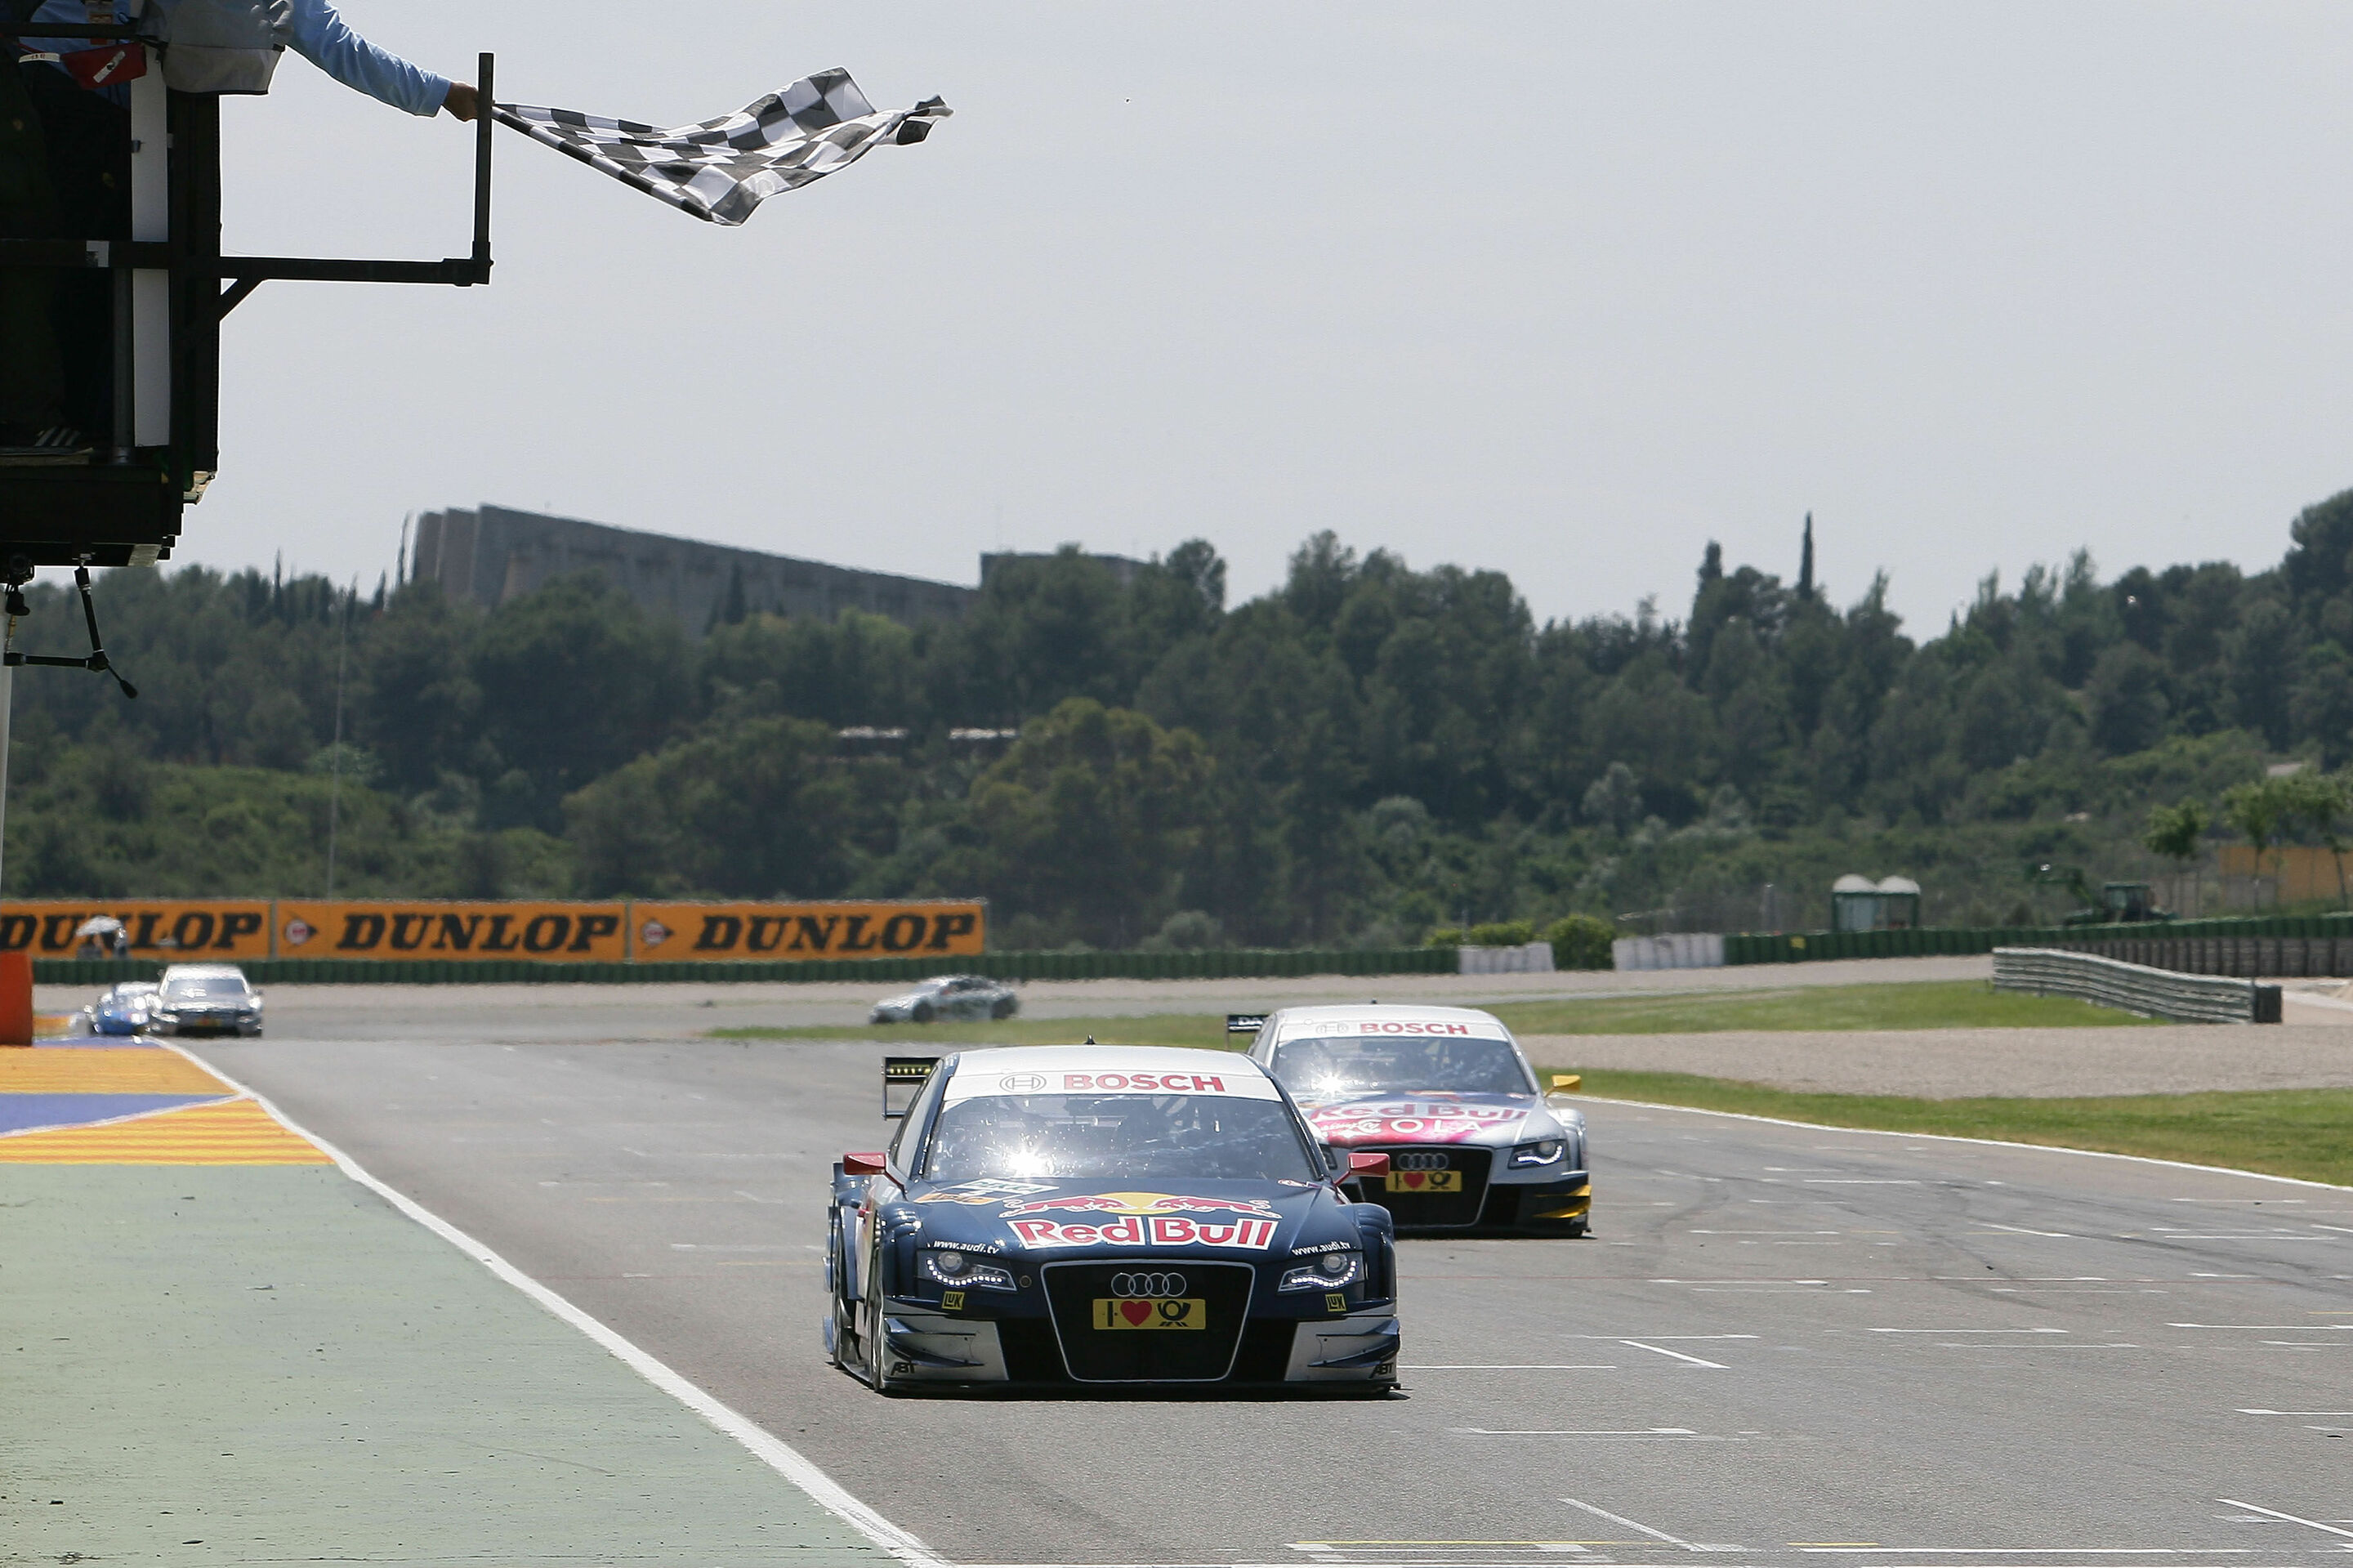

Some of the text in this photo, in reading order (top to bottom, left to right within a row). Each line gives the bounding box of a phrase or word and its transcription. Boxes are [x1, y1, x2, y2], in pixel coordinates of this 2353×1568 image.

[336, 914, 619, 952] DUNLOP
[693, 914, 976, 952] DUNLOP
[1360, 1023, 1469, 1034] BOSCH
[1064, 1074, 1226, 1092] BOSCH
[1427, 1105, 1529, 1119] Bull
[1360, 1119, 1483, 1134] COLA
[1011, 1217, 1275, 1249] Red Bull
[933, 1240, 1000, 1254] www.audi.tv
[1292, 1241, 1351, 1256] www.audi.tv
[891, 1361, 916, 1376] ABT
